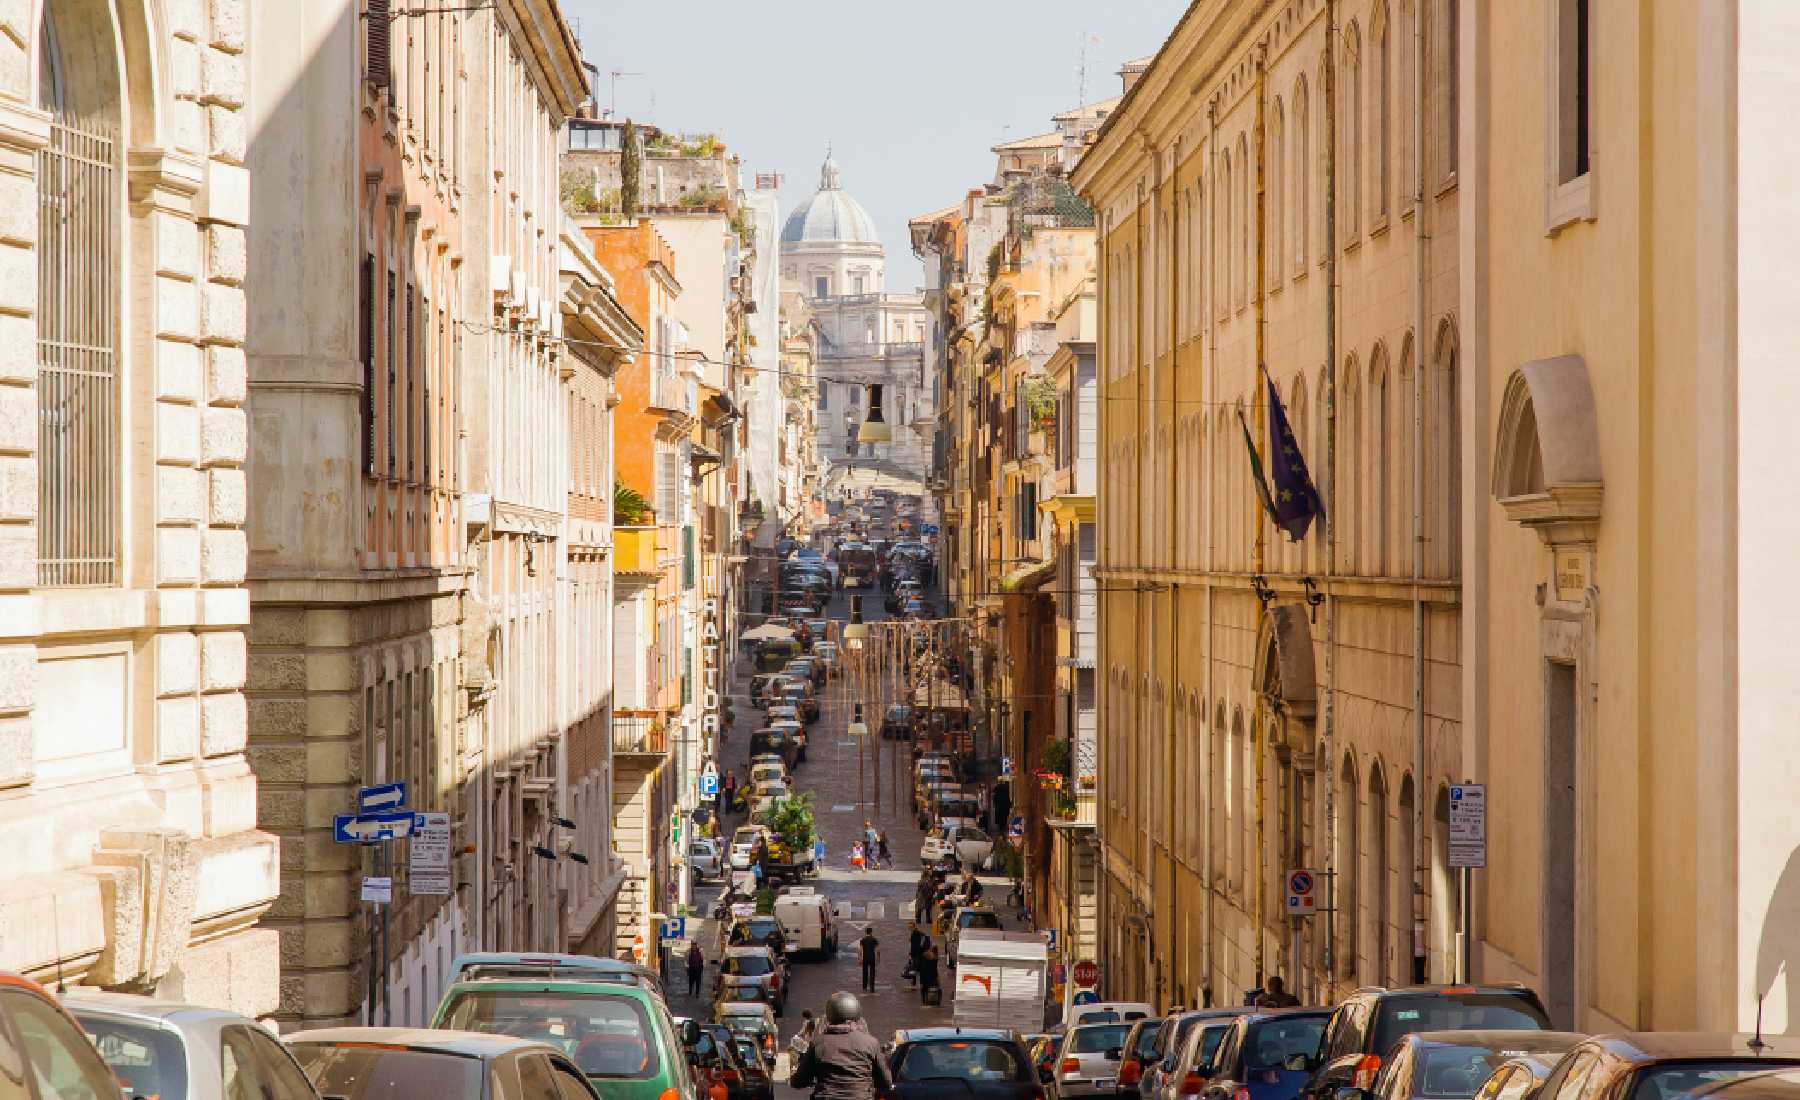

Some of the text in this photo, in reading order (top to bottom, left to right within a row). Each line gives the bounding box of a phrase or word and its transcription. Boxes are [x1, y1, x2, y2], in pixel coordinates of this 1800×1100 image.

[703, 575, 719, 777] TRATTORIA
[704, 777, 716, 793] P
[667, 919, 681, 937] P
[1075, 968, 1097, 980] STOP
